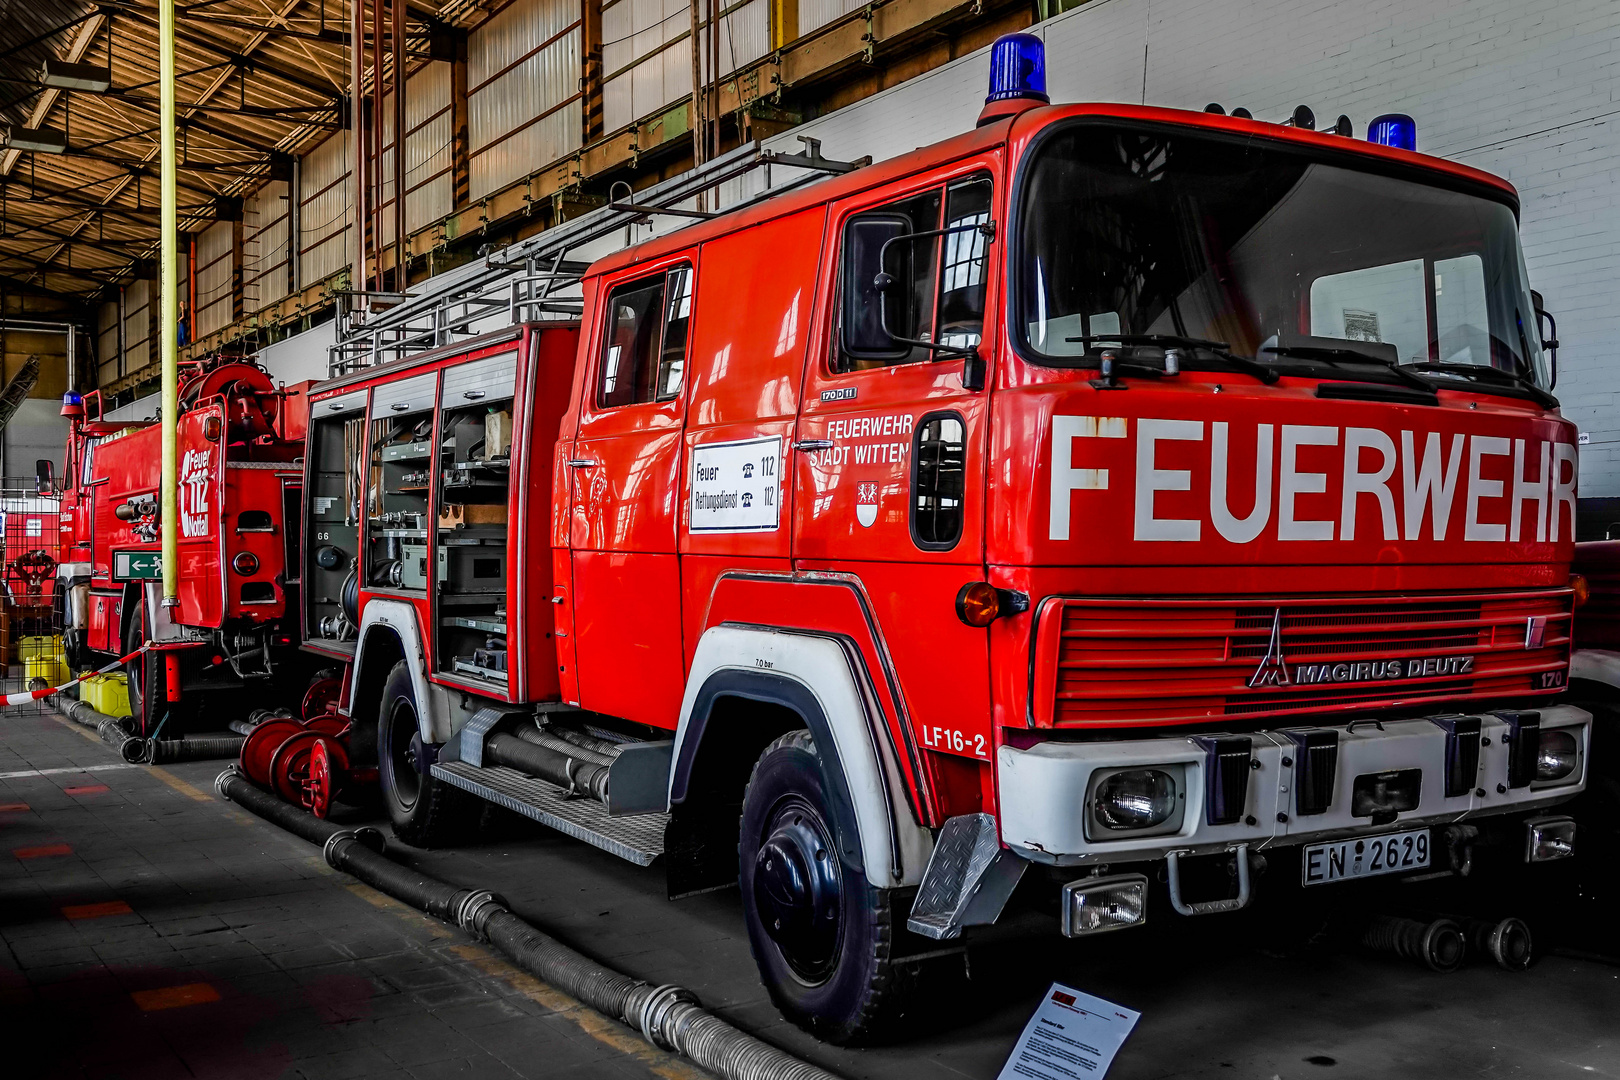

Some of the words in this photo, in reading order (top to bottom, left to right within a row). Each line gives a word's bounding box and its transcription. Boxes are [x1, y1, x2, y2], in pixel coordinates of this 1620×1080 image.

[822, 392, 836, 400] 170
[845, 389, 852, 397] 11
[827, 414, 913, 440] FEUERWEHR
[190, 449, 211, 471] Feuer
[810, 446, 850, 467] STADT
[855, 442, 909, 464] WITTEN
[696, 463, 719, 481] Feuer
[761, 456, 774, 476] 112
[1049, 415, 1580, 544] FEUERWEHR
[189, 468, 209, 514] 112
[695, 490, 738, 512] Rettungsdienst
[764, 486, 774, 506] 112
[189, 514, 208, 537] Notfall
[764, 660, 774, 668] bar
[1296, 661, 1402, 684] MAGIRUS
[1407, 656, 1474, 678] DEUTZ
[1541, 671, 1562, 688] 170
[923, 724, 987, 756] LF16-2
[1369, 833, 1428, 872] 2629
